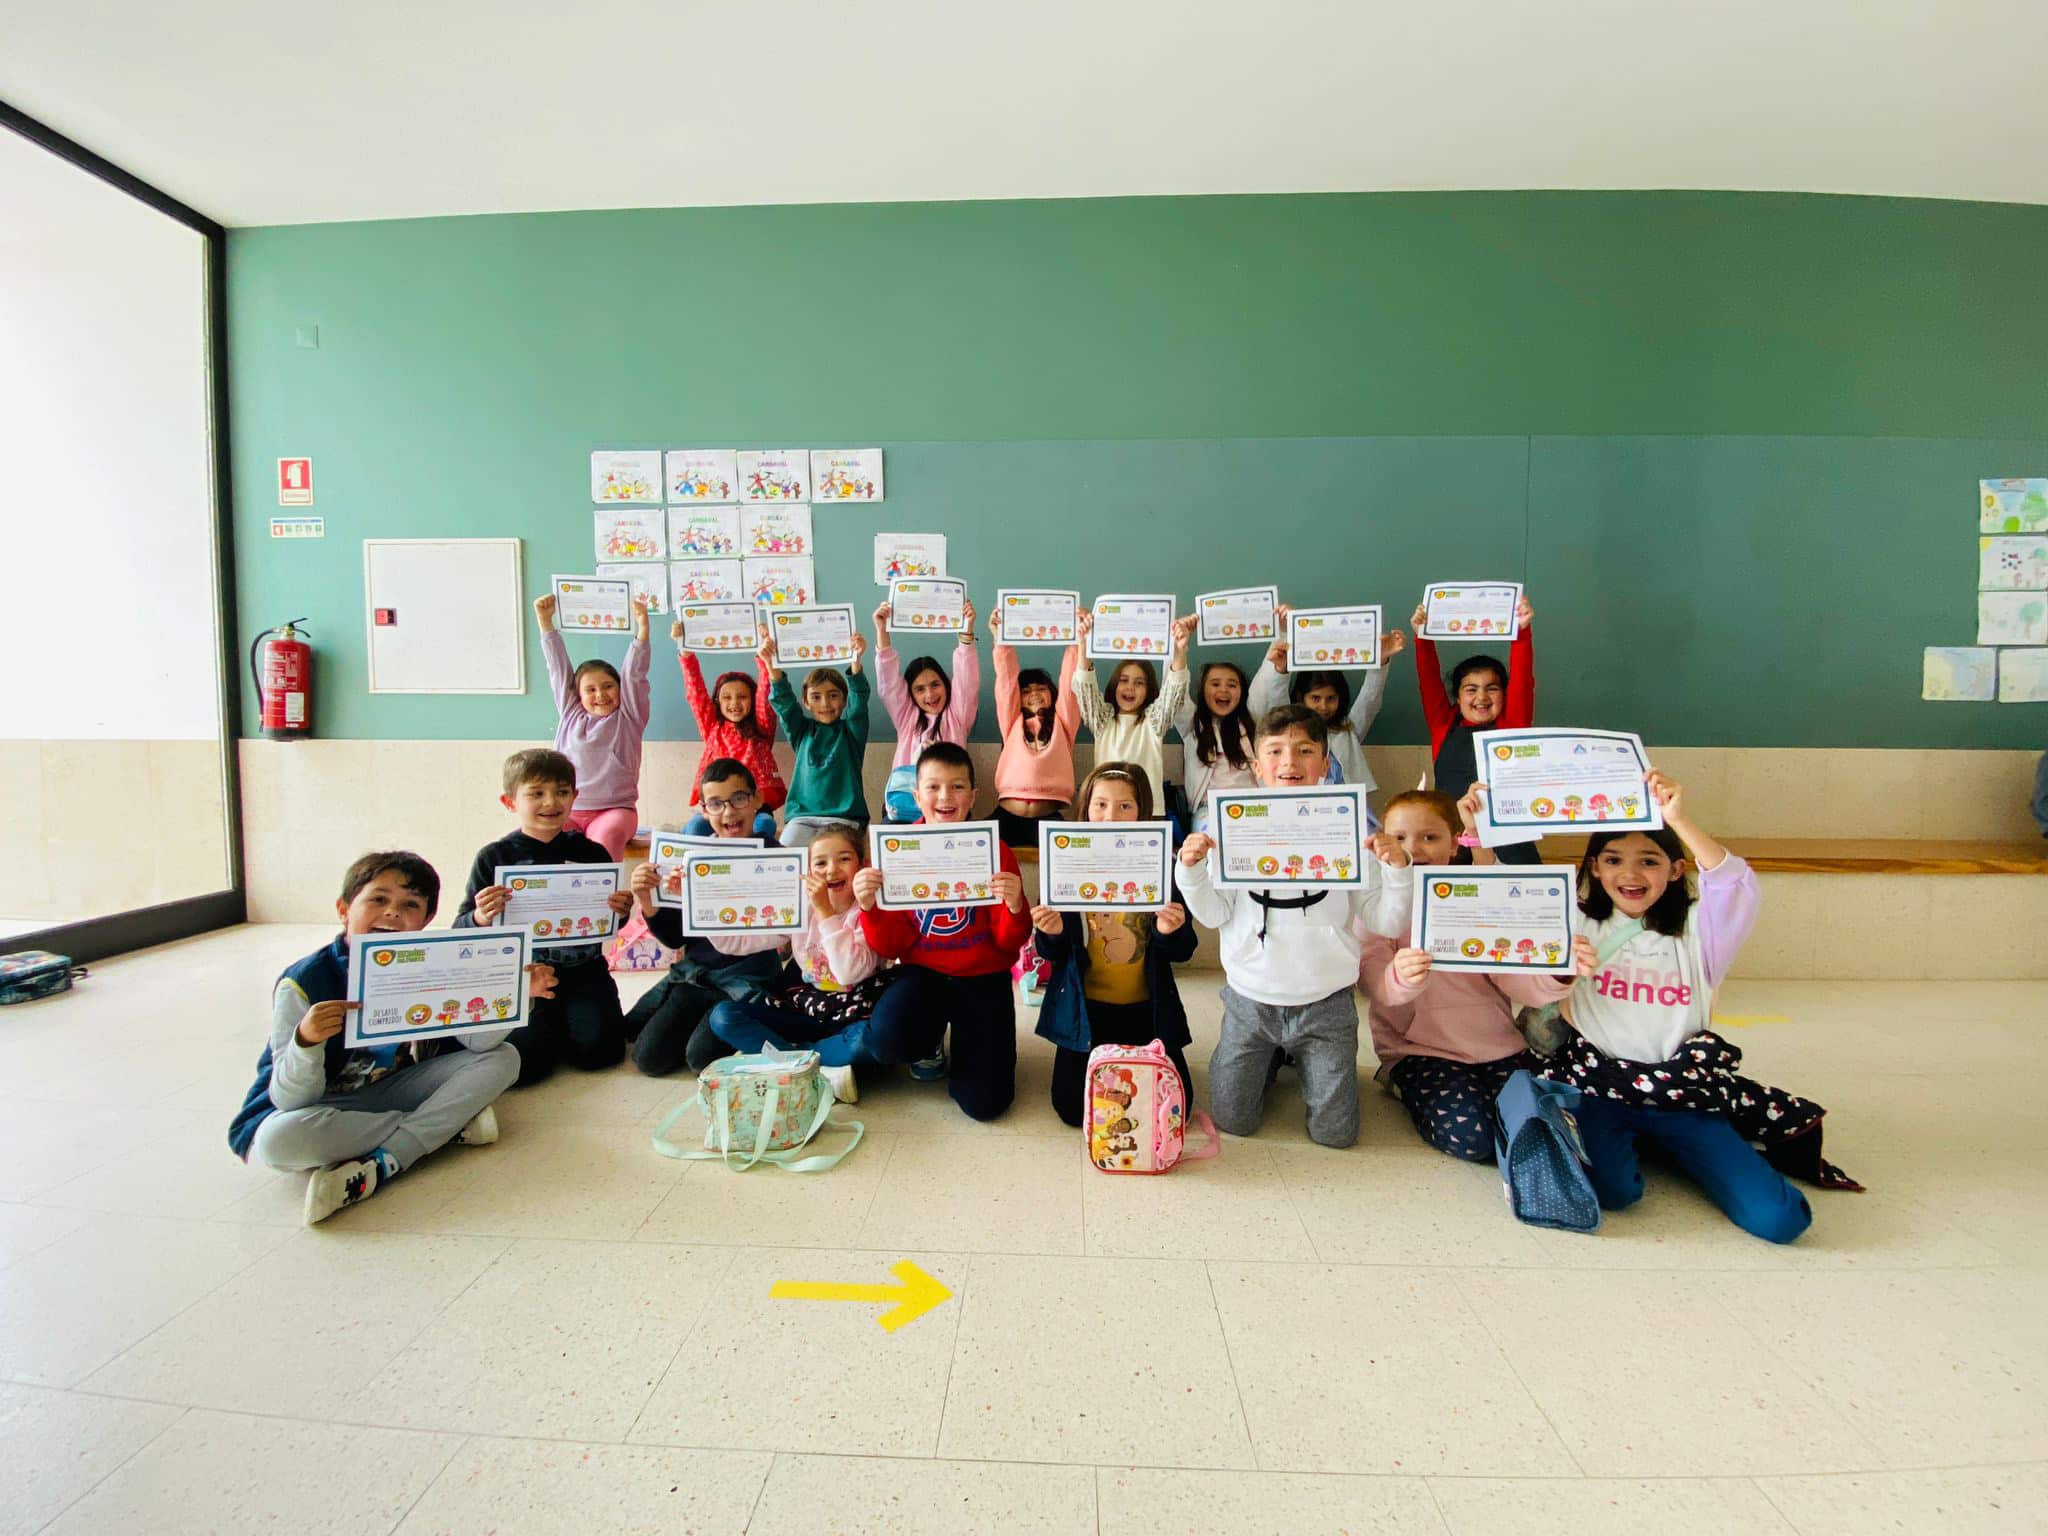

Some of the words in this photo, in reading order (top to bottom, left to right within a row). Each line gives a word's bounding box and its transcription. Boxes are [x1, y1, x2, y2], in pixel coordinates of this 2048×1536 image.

[757, 460, 788, 468] CARNAVAL
[1592, 970, 1692, 1006] dance
[373, 1007, 398, 1018] DESAFIO
[368, 1015, 402, 1026] CUMPRIDO!
